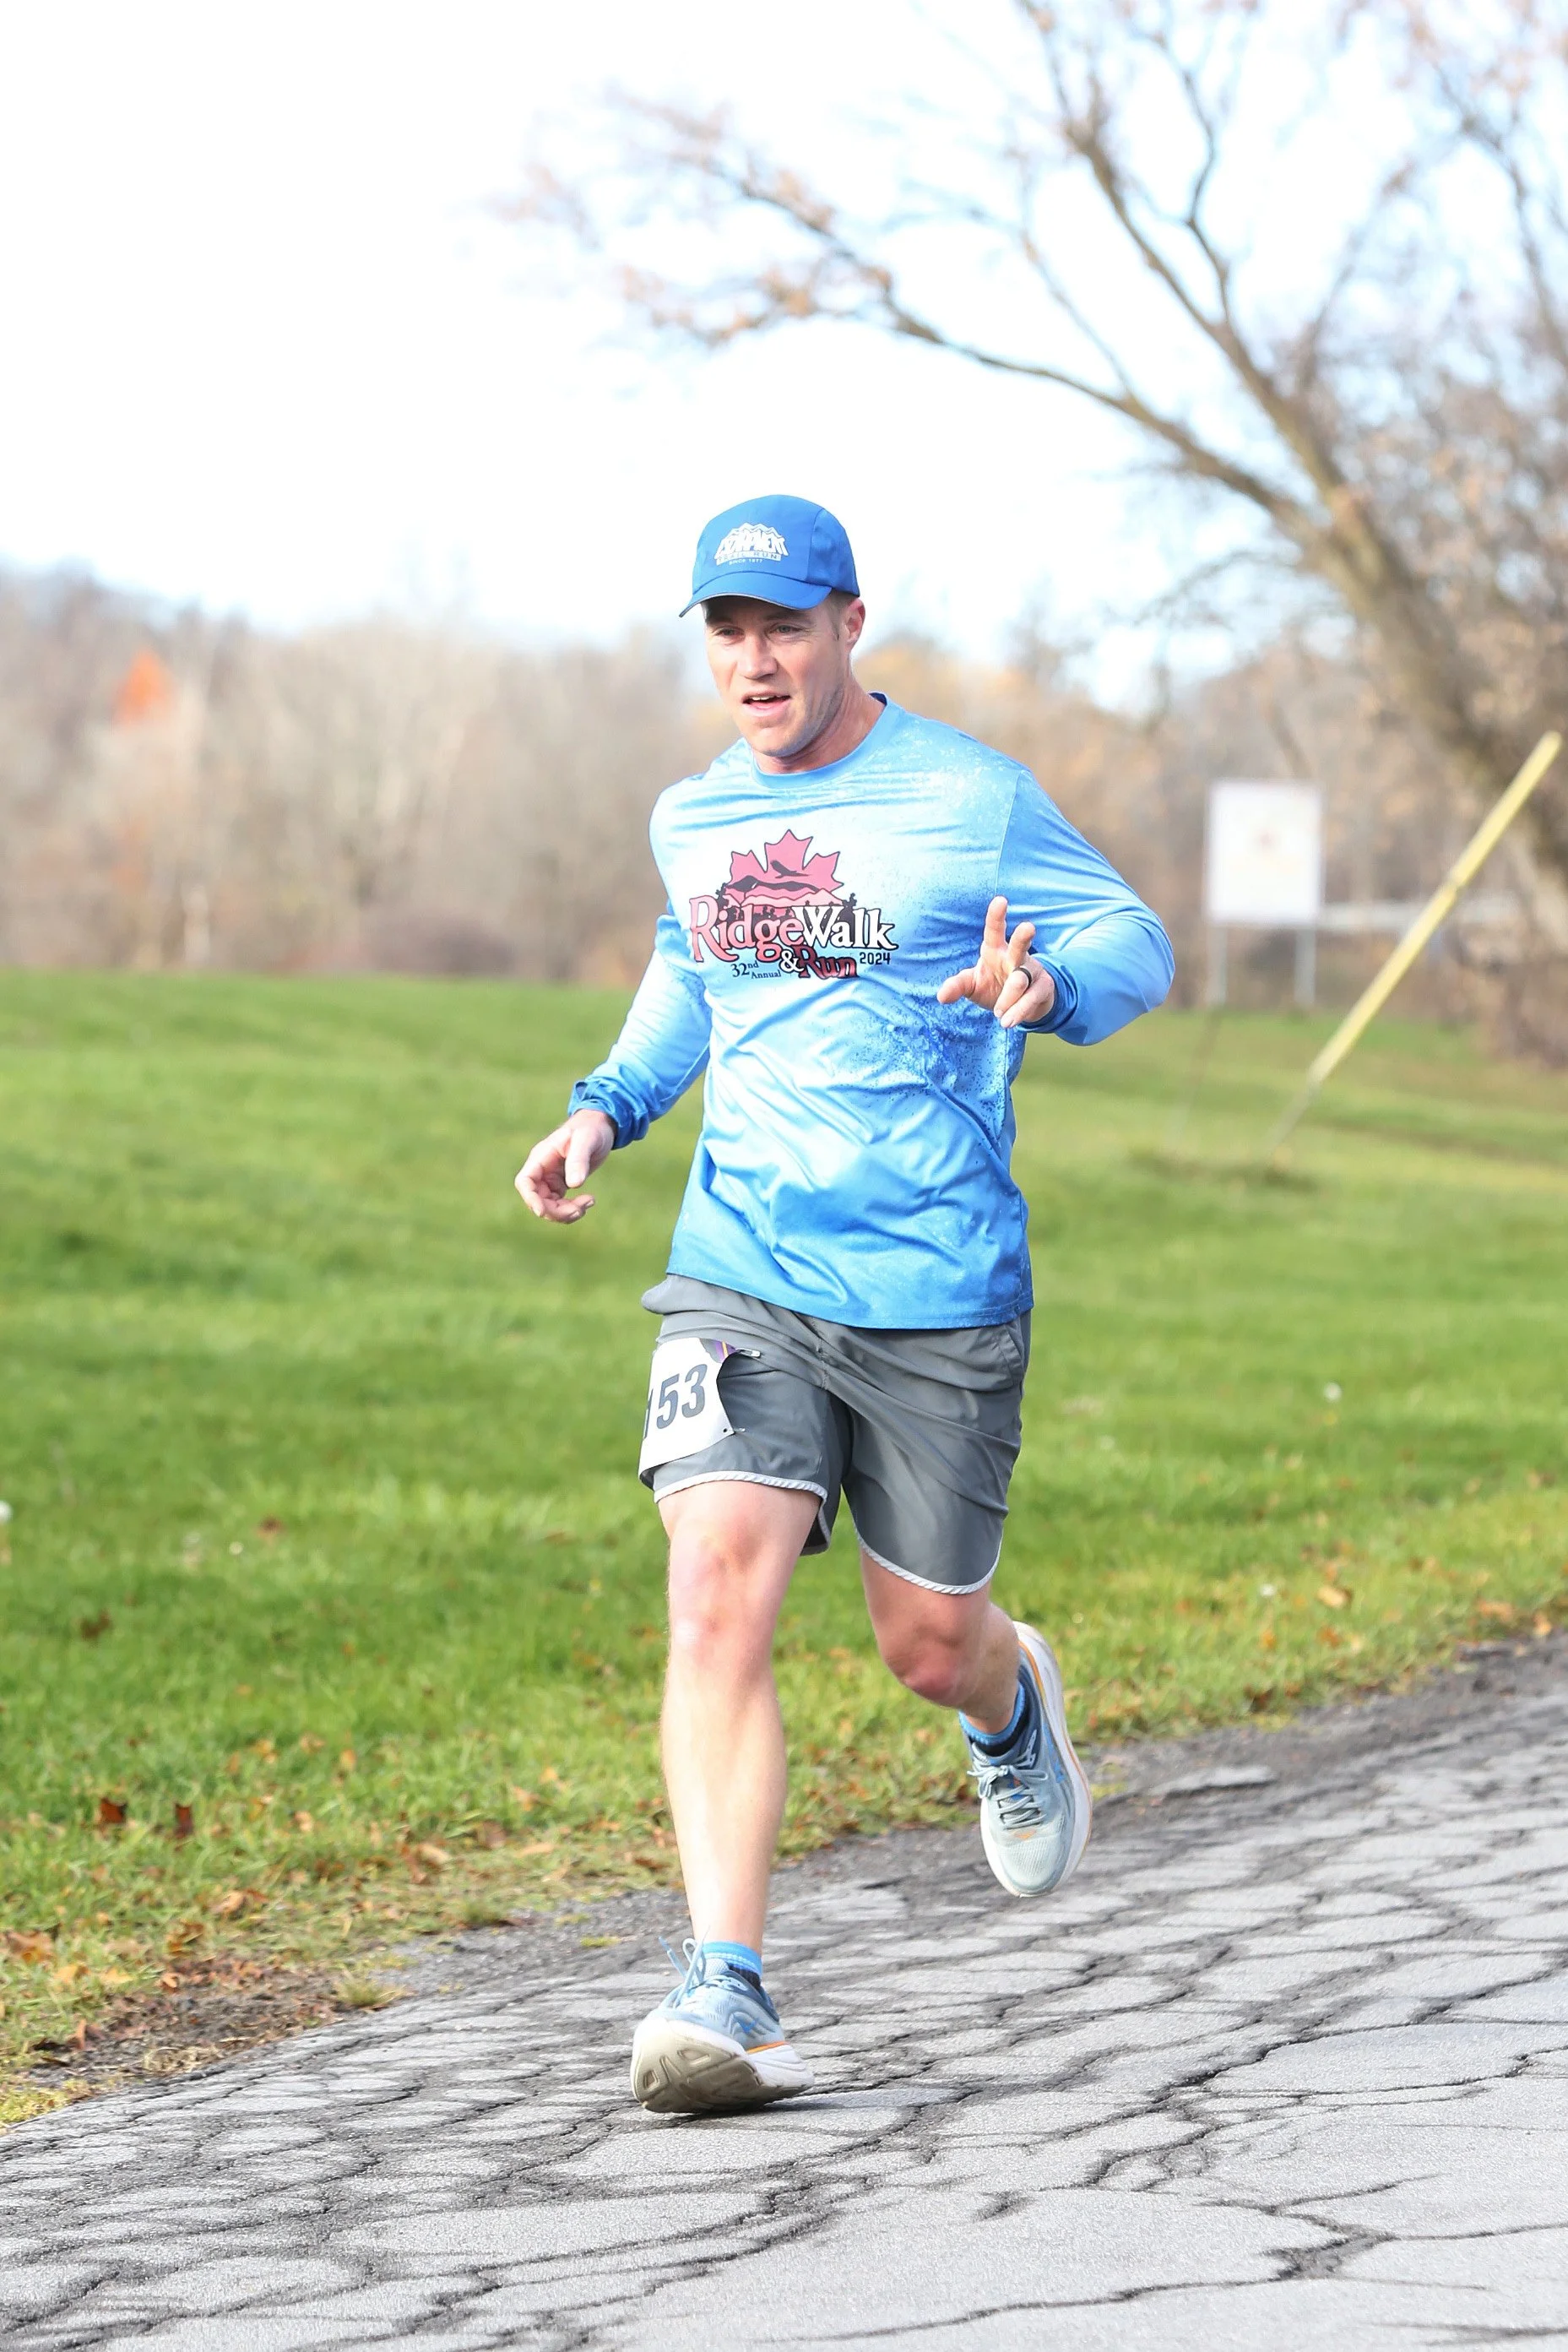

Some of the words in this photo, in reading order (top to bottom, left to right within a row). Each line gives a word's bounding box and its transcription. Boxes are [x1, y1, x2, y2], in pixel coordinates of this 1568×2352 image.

[859, 952, 892, 965] 2024
[730, 961, 759, 977] 32nd
[751, 970, 782, 979] Annual
